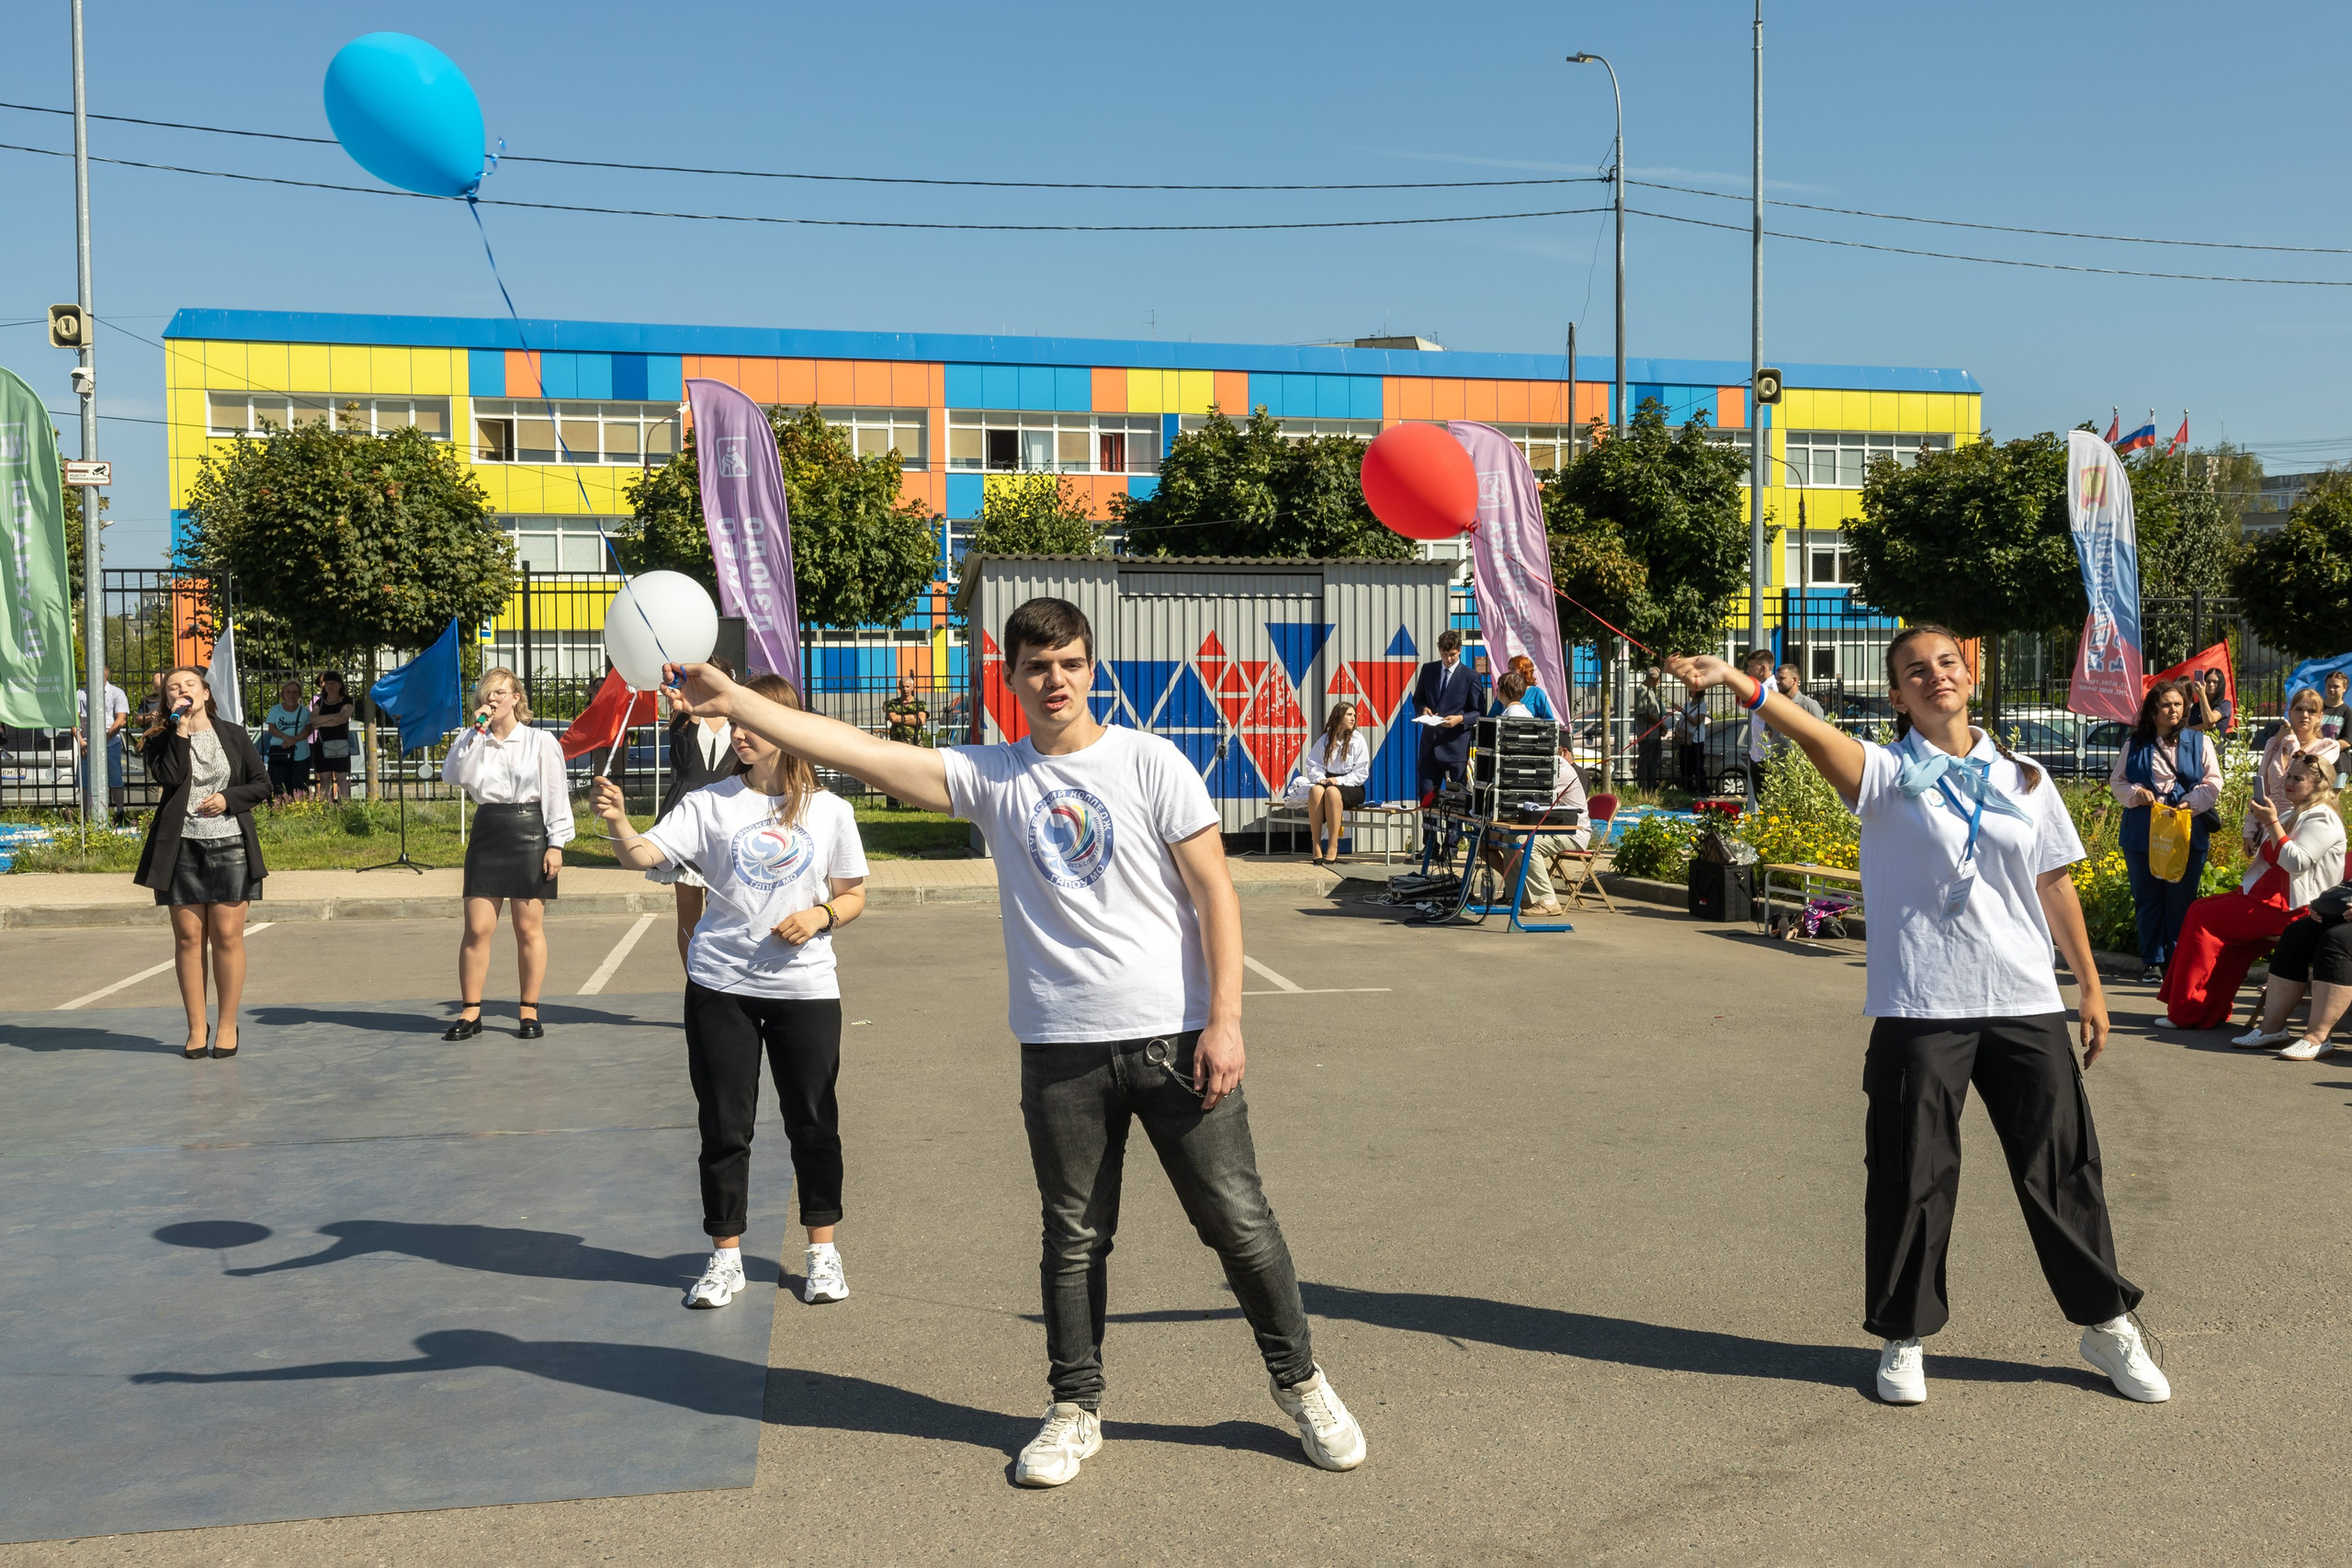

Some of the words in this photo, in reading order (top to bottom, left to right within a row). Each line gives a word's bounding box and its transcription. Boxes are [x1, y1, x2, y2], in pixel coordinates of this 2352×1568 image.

[732, 818, 776, 863] ГУБЕРНСКИ
[1029, 789, 1067, 853] ГУБЕСКИЙ
[1069, 790, 1112, 831] КОЛЛЕДЖ
[1068, 860, 1083, 868] ВЕСЬ
[1083, 845, 1100, 867] СПЕКТР
[1093, 817, 1102, 845] ЗНАНИЙ
[749, 880, 780, 891] ГАПОУ
[783, 873, 797, 885] МО
[1050, 874, 1088, 889] ГАПОУ
[1091, 864, 1105, 882] МО
